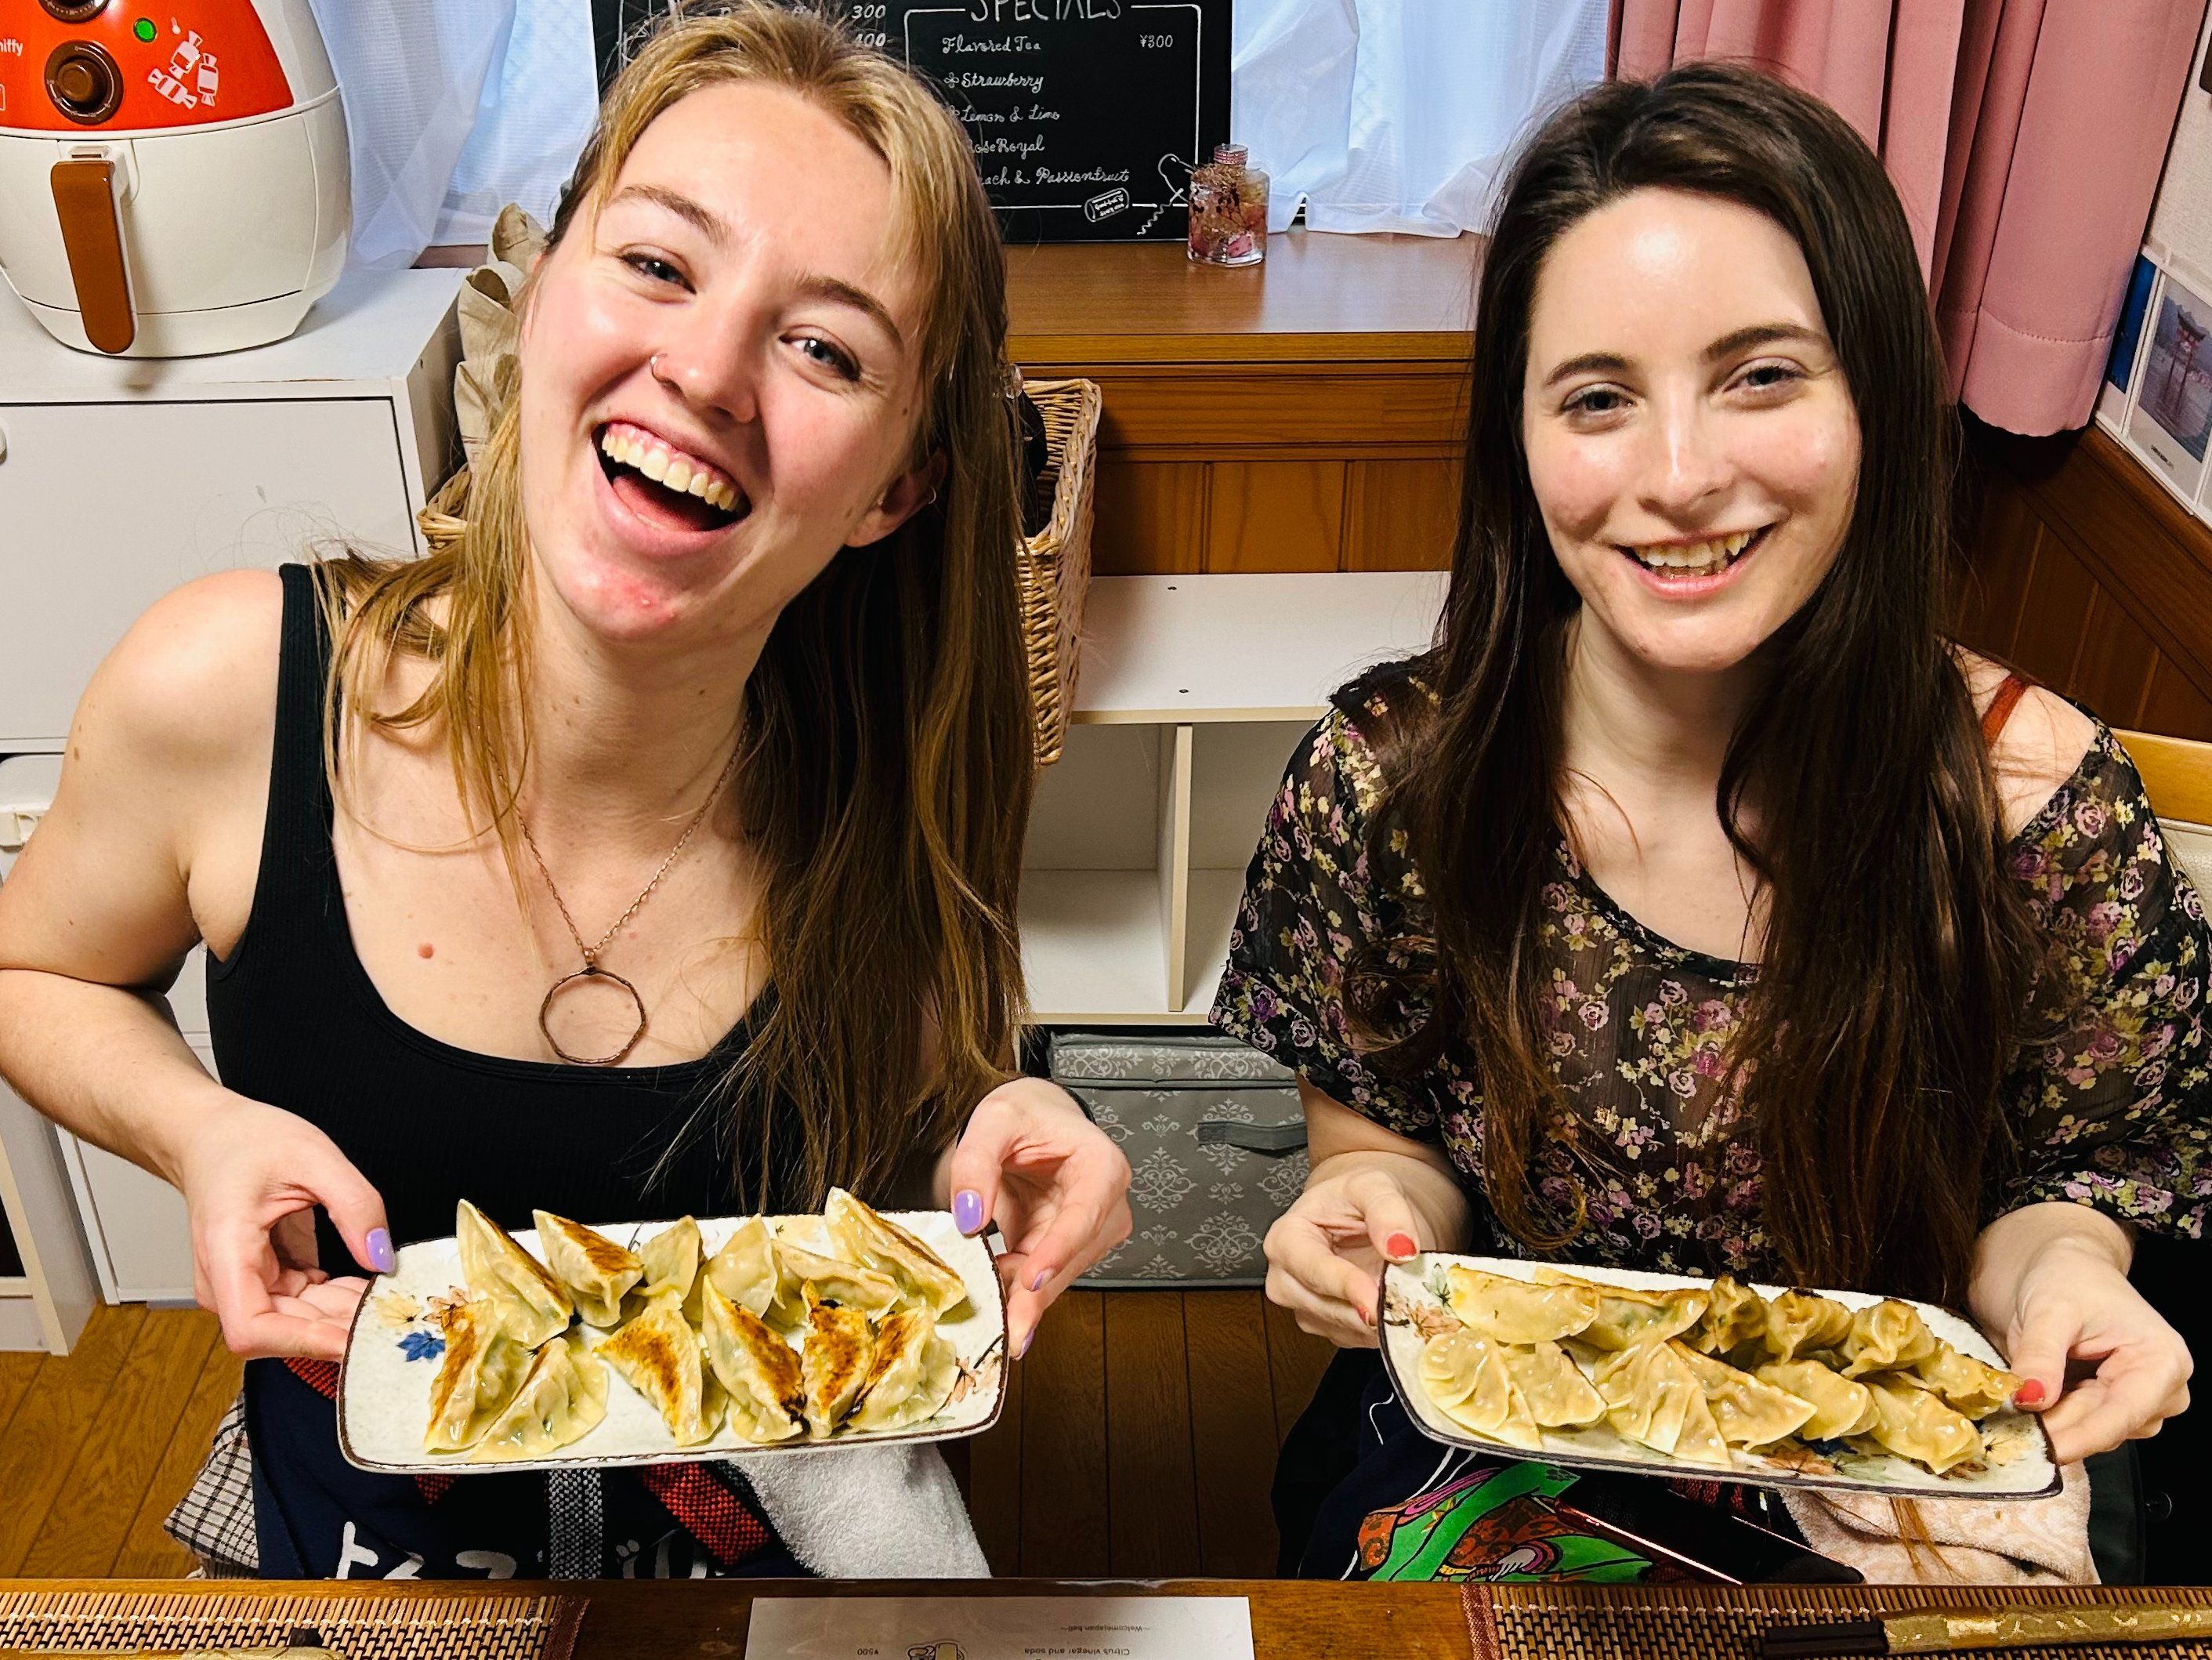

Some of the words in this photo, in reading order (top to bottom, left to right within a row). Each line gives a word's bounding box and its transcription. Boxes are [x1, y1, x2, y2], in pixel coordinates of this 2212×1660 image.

[851, 4, 886, 20] 300
[942, 34, 1012, 54] Flavored
[1139, 34, 1174, 49] ¥300
[961, 72, 1044, 94] Strawberry
[961, 104, 1005, 122] Lemon
[1009, 106, 1023, 122] &
[1014, 169, 1030, 185] &
[1102, 1647, 1130, 1656] Citrus
